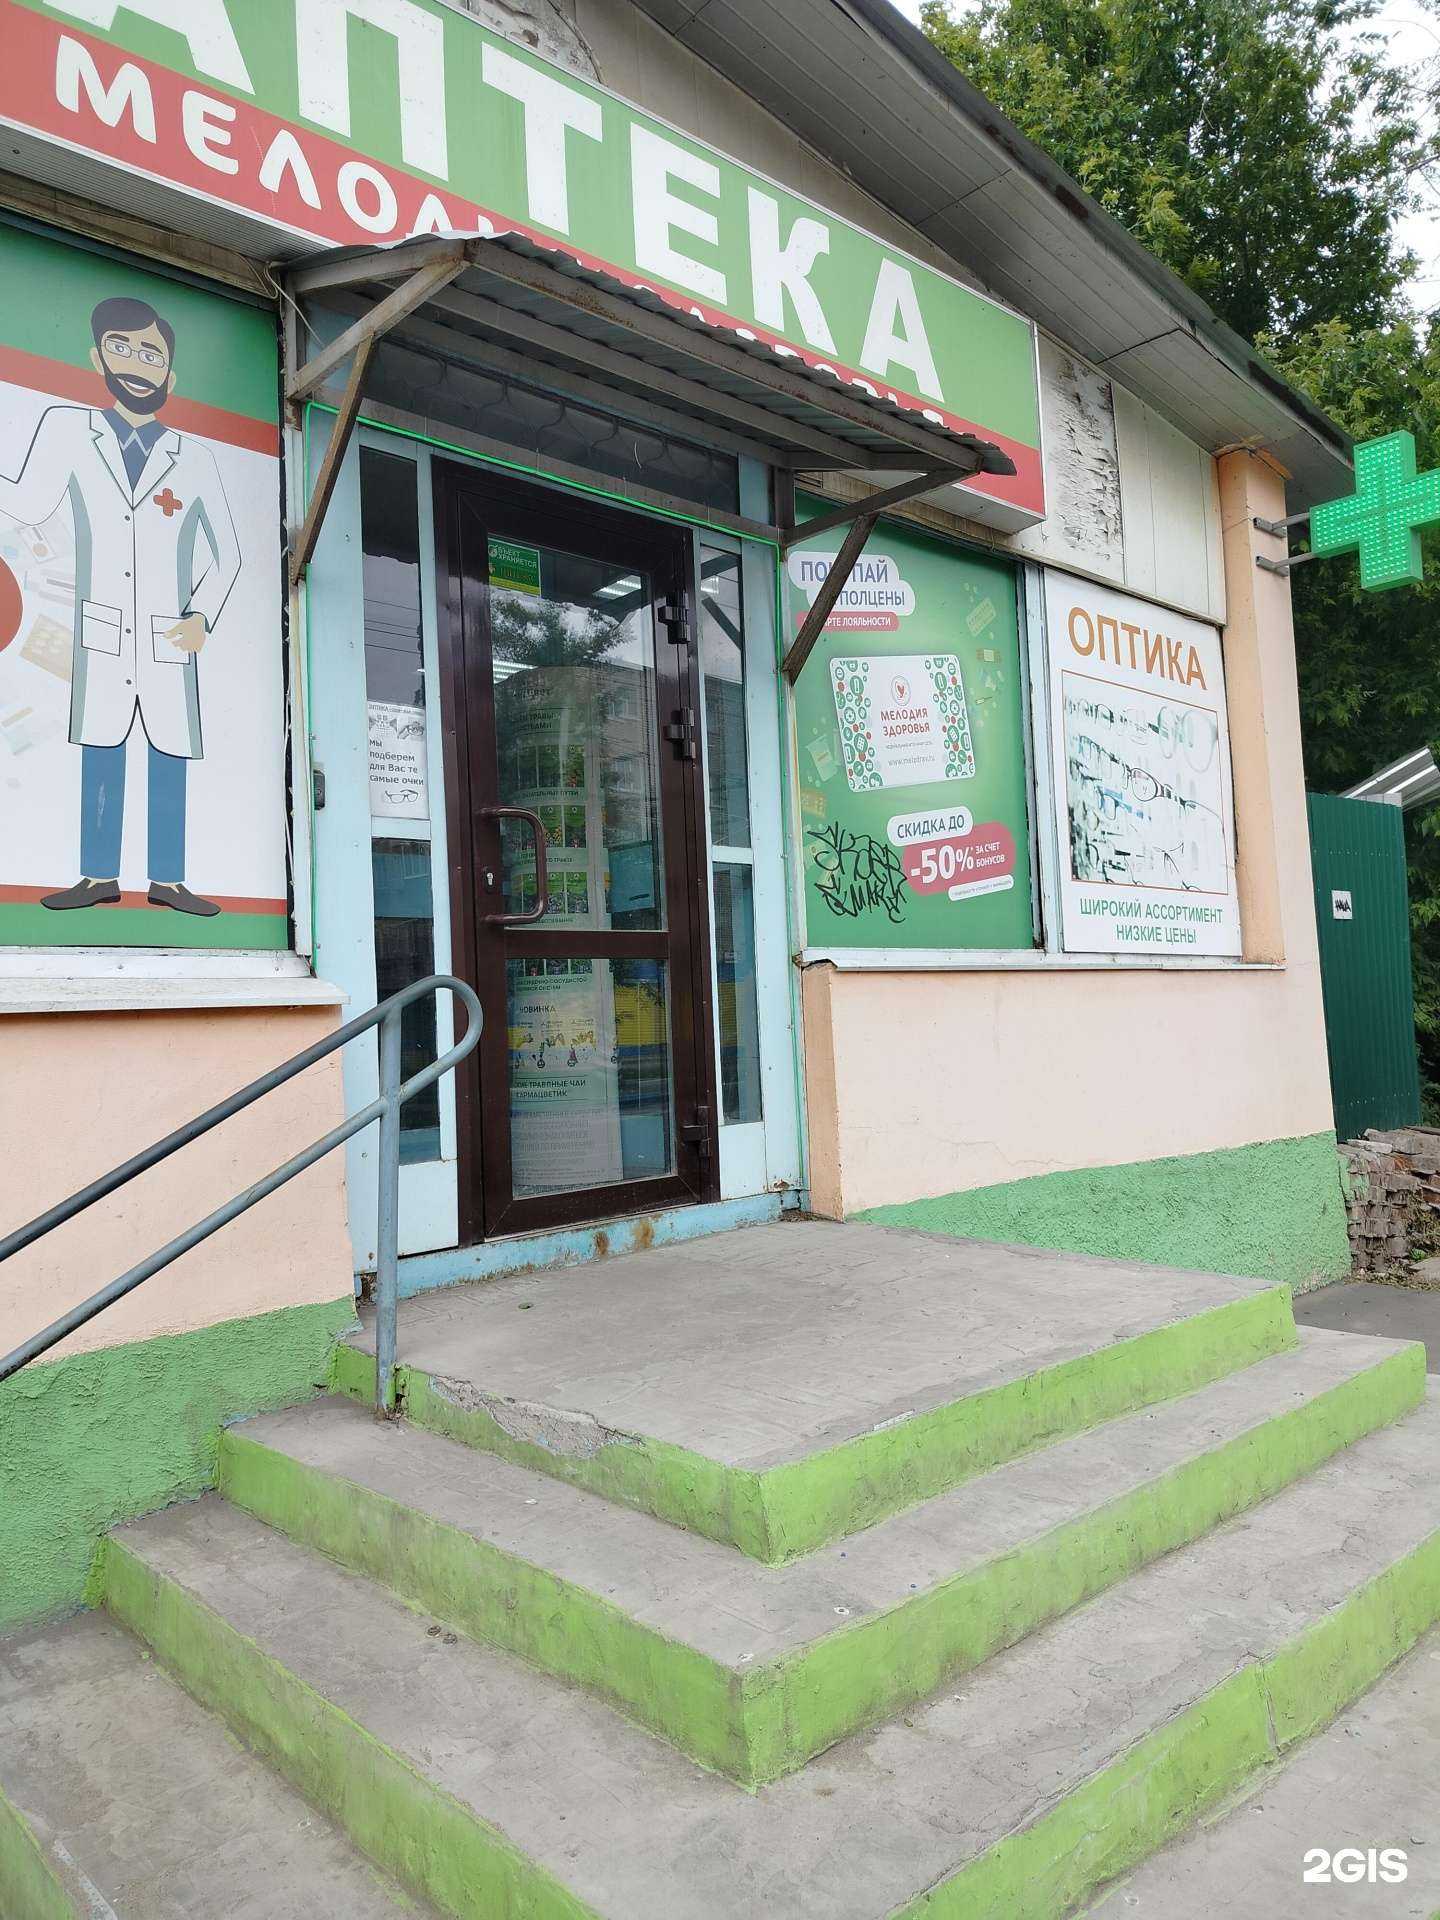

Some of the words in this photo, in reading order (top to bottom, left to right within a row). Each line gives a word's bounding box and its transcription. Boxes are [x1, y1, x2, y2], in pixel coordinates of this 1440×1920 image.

[55, 34, 582, 267] МЕЛОД
[801, 559, 889, 583] ПОПАЙ
[840, 590, 905, 608] ПОЛЦЕНЫ
[842, 617, 891, 627] ЛОЯЛЬНОСТИ
[1067, 606, 1208, 691] ОПТИКА
[880, 708, 929, 721] МЕЛОДИЯ
[882, 722, 931, 738] ЗДОРОВЬЯ
[369, 751, 416, 762] подберем
[369, 763, 386, 771] для
[387, 763, 406, 773] Вас
[407, 766, 418, 774] те
[369, 774, 399, 784] самые
[401, 777, 424, 786] очки
[897, 818, 946, 839] СКИДКА
[948, 814, 965, 832] ДО
[975, 845, 985, 855] ЗА
[975, 854, 1006, 869] БОНУСОВ
[1079, 897, 1142, 918] ШИРОКИЙ
[1145, 903, 1223, 924] АССОРТИМЕНТ
[1116, 923, 1162, 942] НИЗКИЕ
[1165, 927, 1197, 945] ЦЕНЫ
